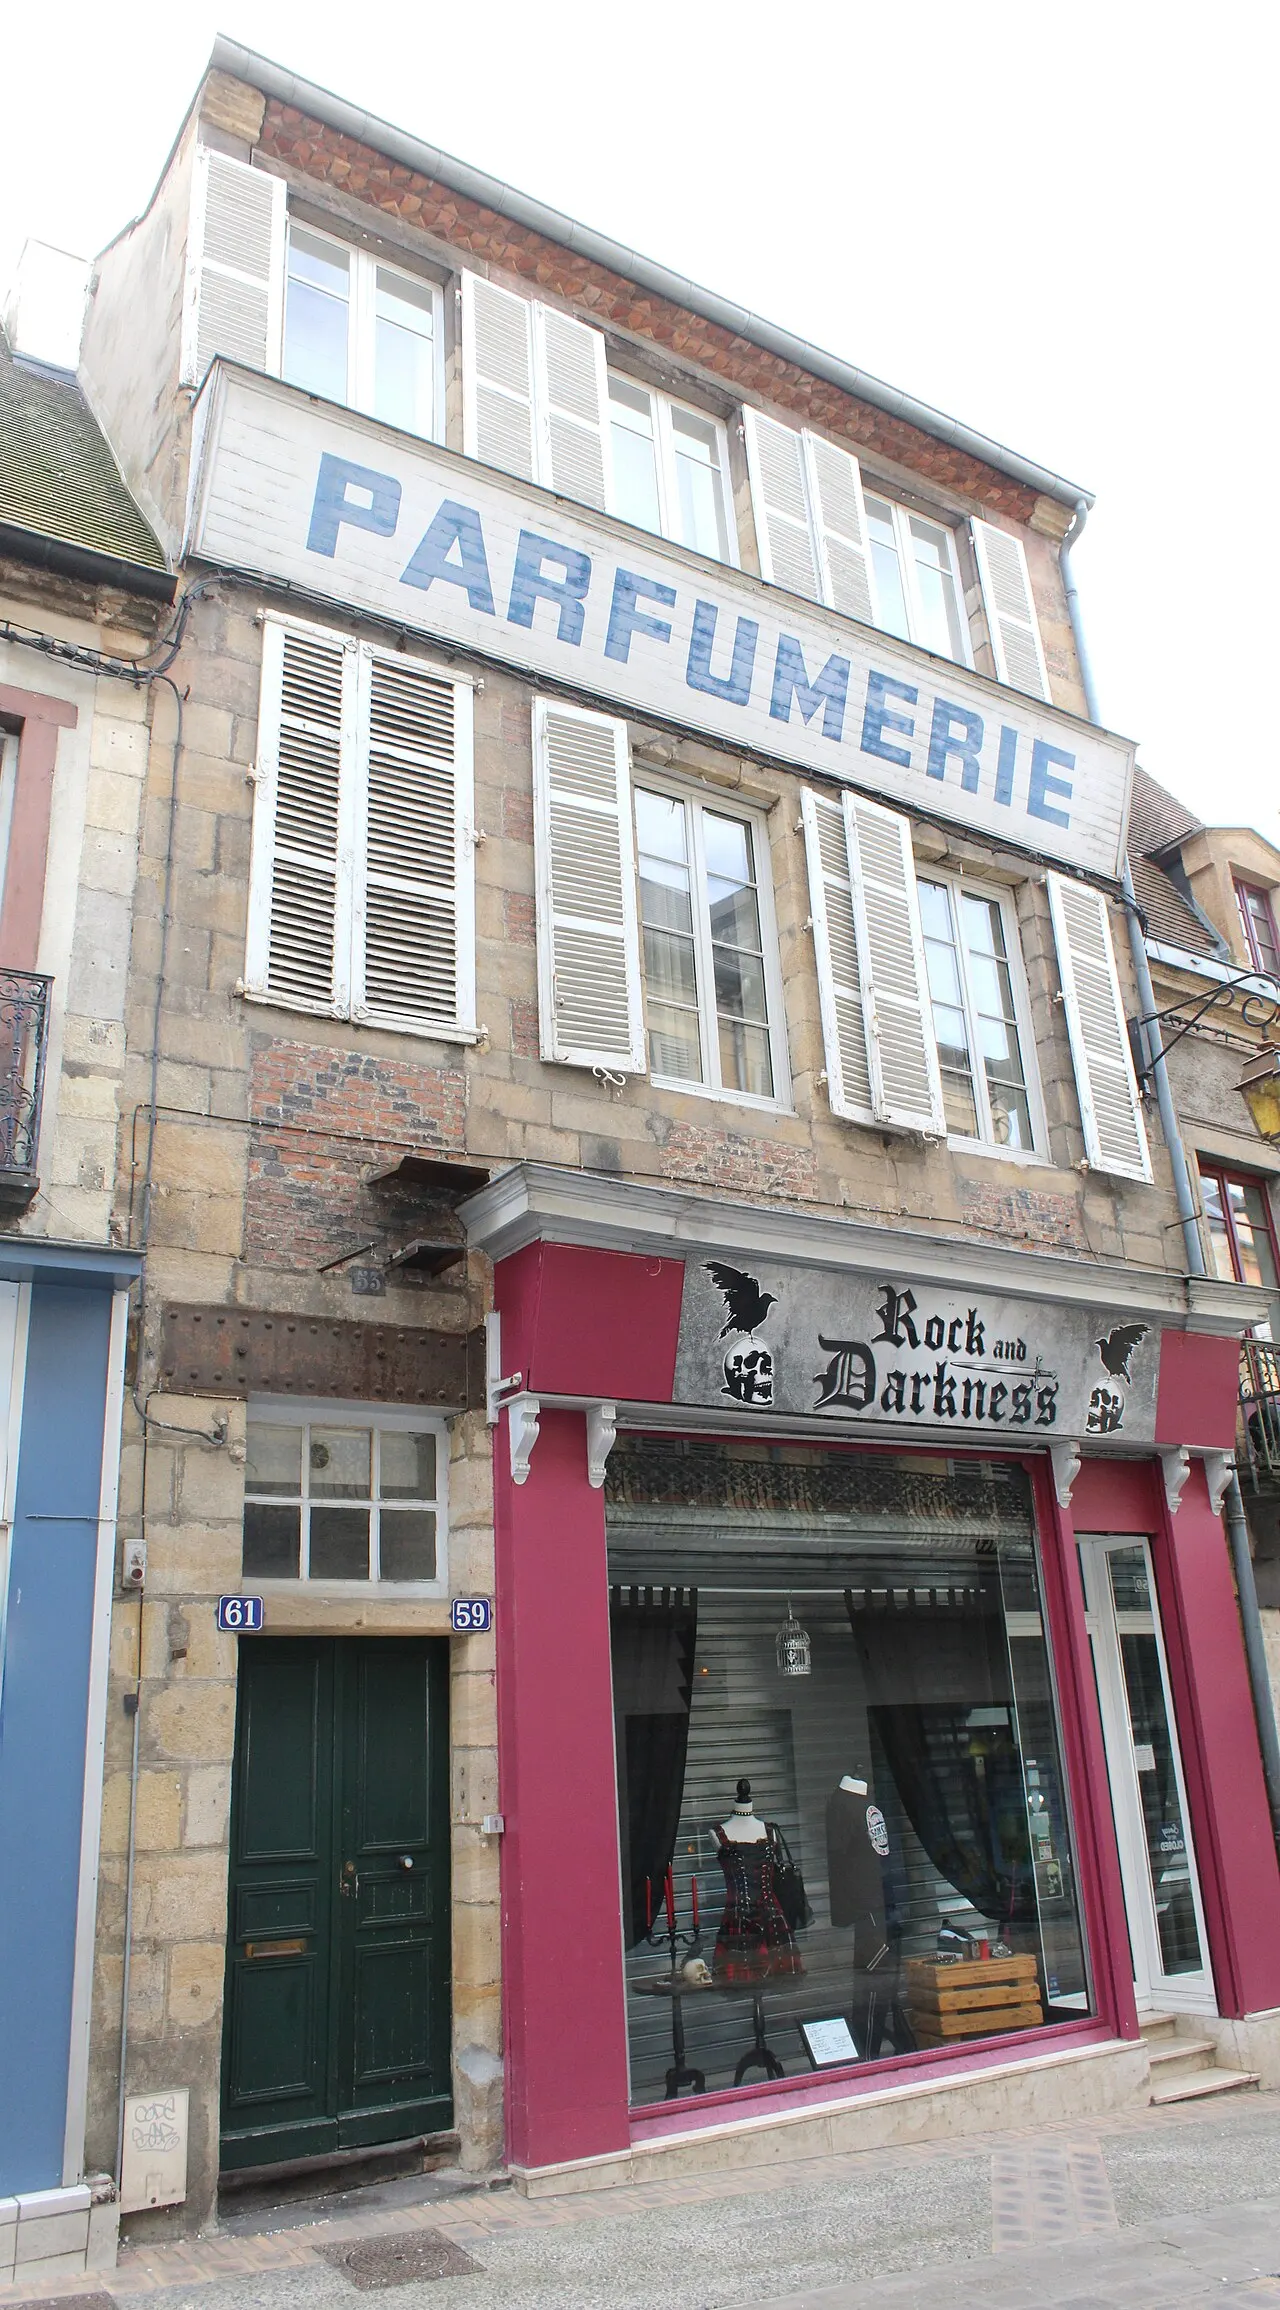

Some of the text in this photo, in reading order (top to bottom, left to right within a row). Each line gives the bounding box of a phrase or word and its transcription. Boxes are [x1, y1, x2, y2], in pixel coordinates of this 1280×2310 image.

[307, 453, 1075, 829] PARFUMERIE
[871, 1284, 1027, 1362] Rock and
[813, 1333, 1060, 1426] Darkness
[225, 1599, 255, 1626] 61
[456, 1602, 485, 1627] 59
